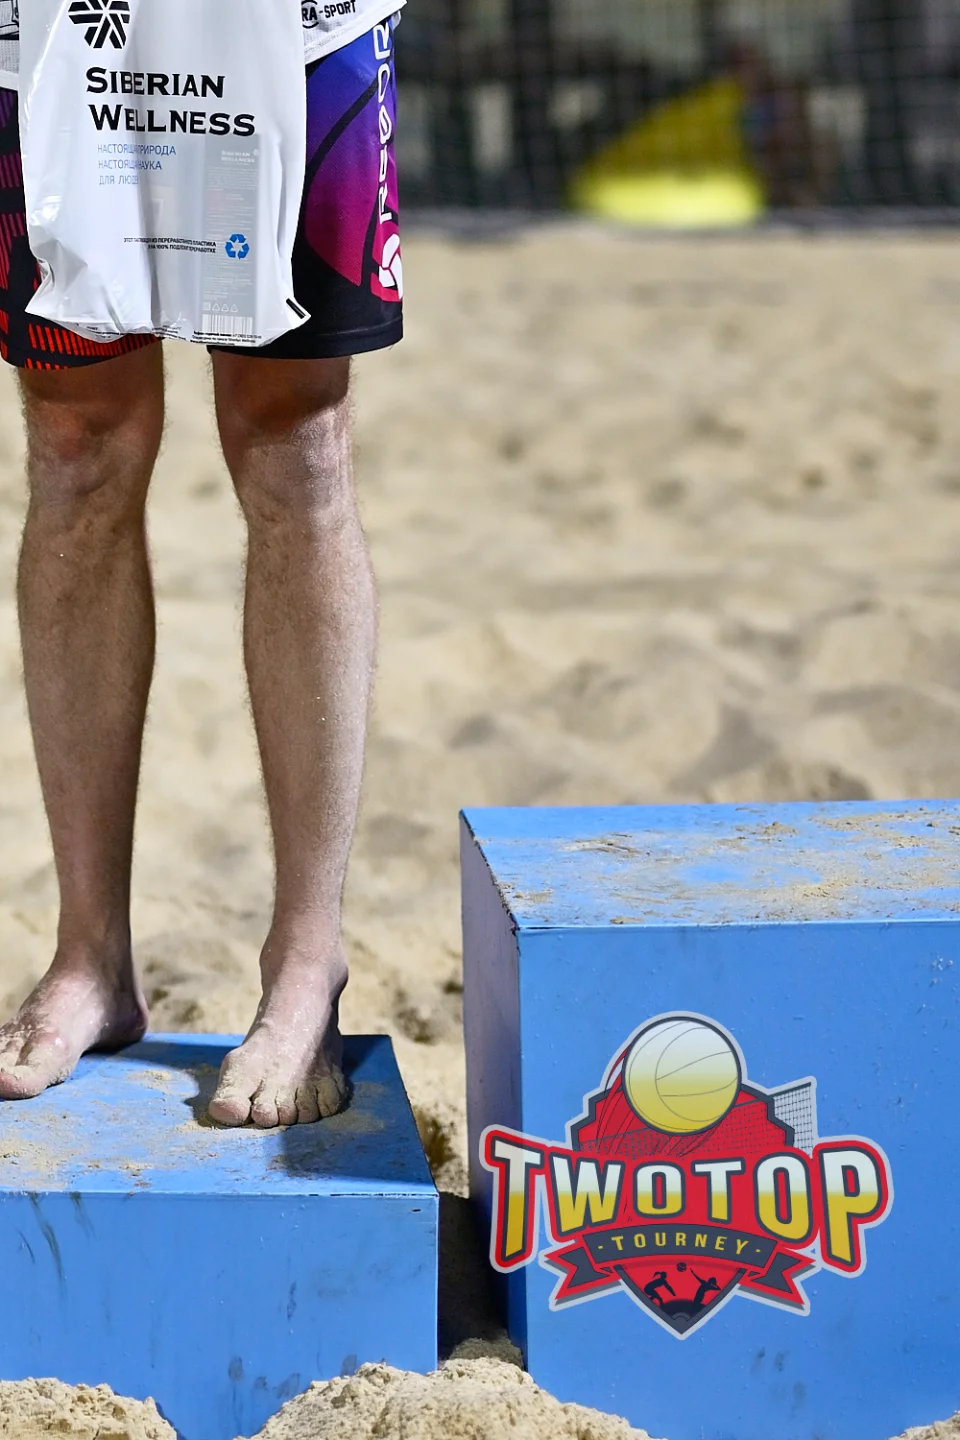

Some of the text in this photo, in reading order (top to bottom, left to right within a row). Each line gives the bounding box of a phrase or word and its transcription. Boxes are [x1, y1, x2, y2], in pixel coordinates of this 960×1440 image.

[86, 66, 225, 98] SIBERIAN
[88, 104, 256, 137] WELLNESS
[99, 175, 115, 186] ДЛЯ
